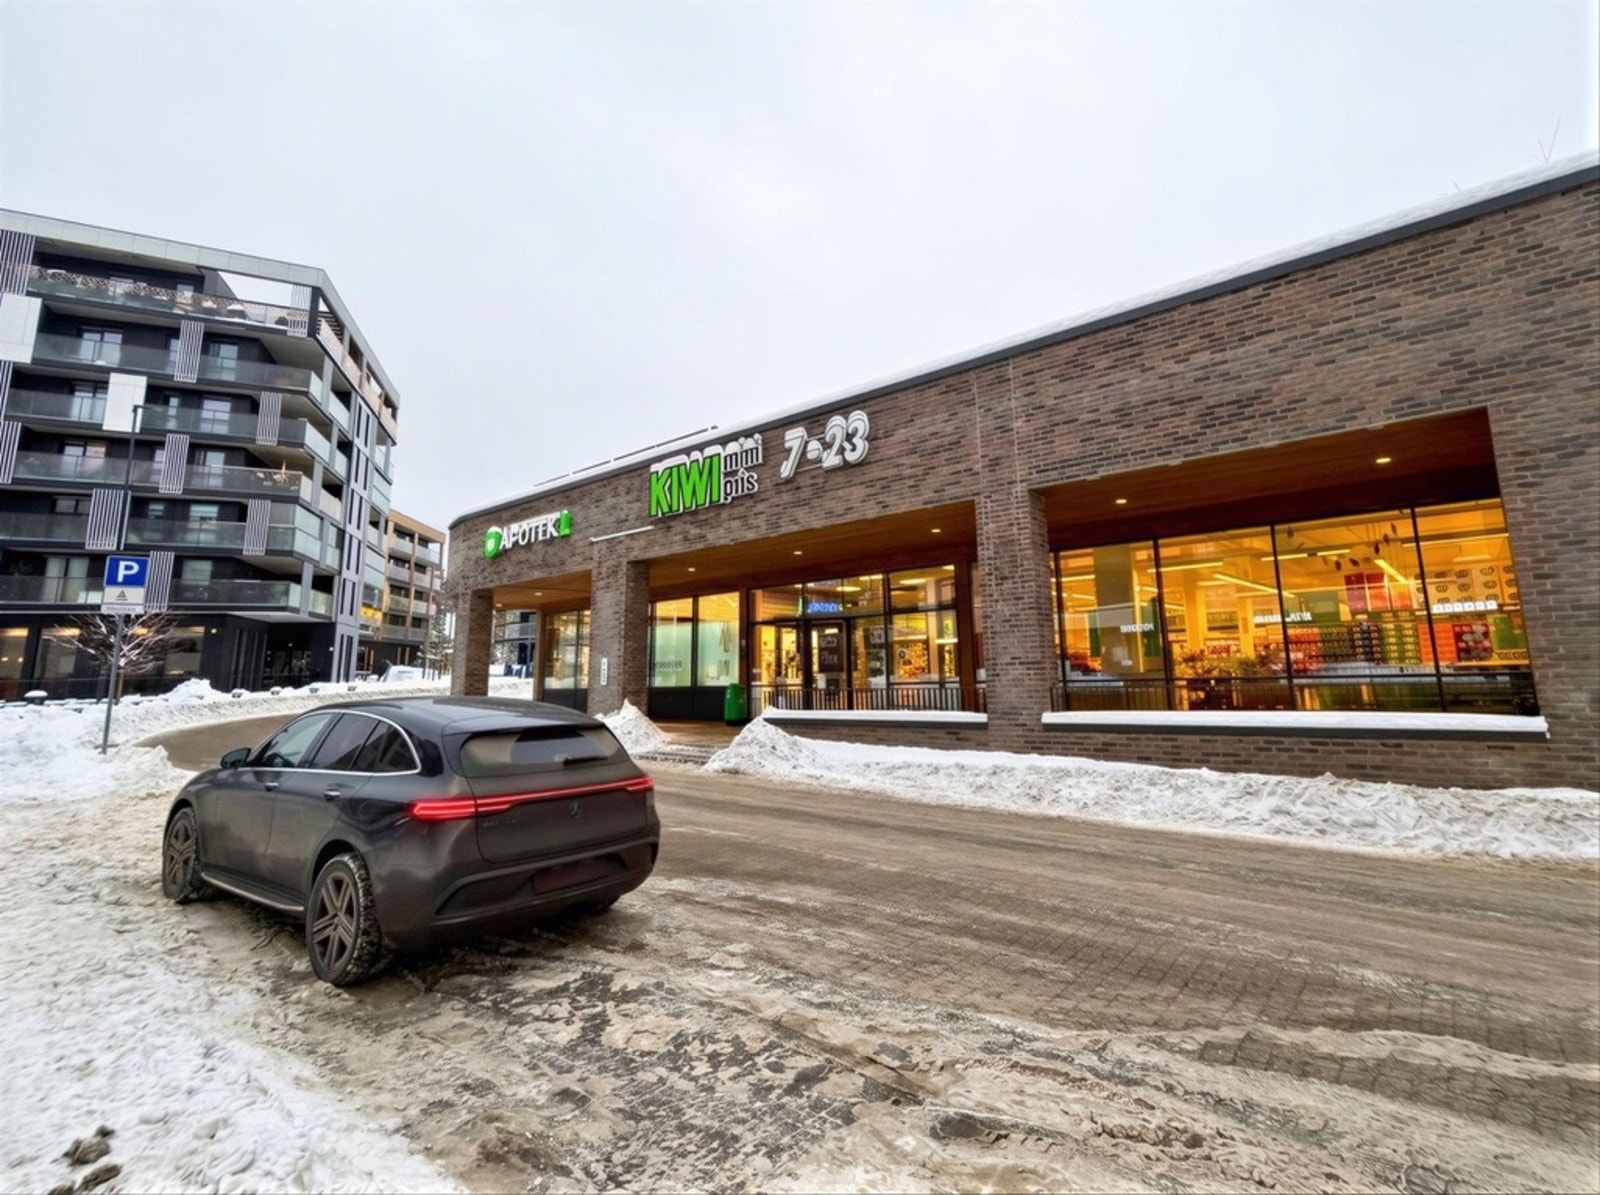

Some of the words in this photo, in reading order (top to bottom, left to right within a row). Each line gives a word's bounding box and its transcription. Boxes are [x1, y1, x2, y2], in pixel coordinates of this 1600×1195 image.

[780, 410, 869, 479] 7-23
[648, 449, 722, 518] KIWI
[499, 511, 560, 551] APOTEK
[117, 560, 139, 583] P
